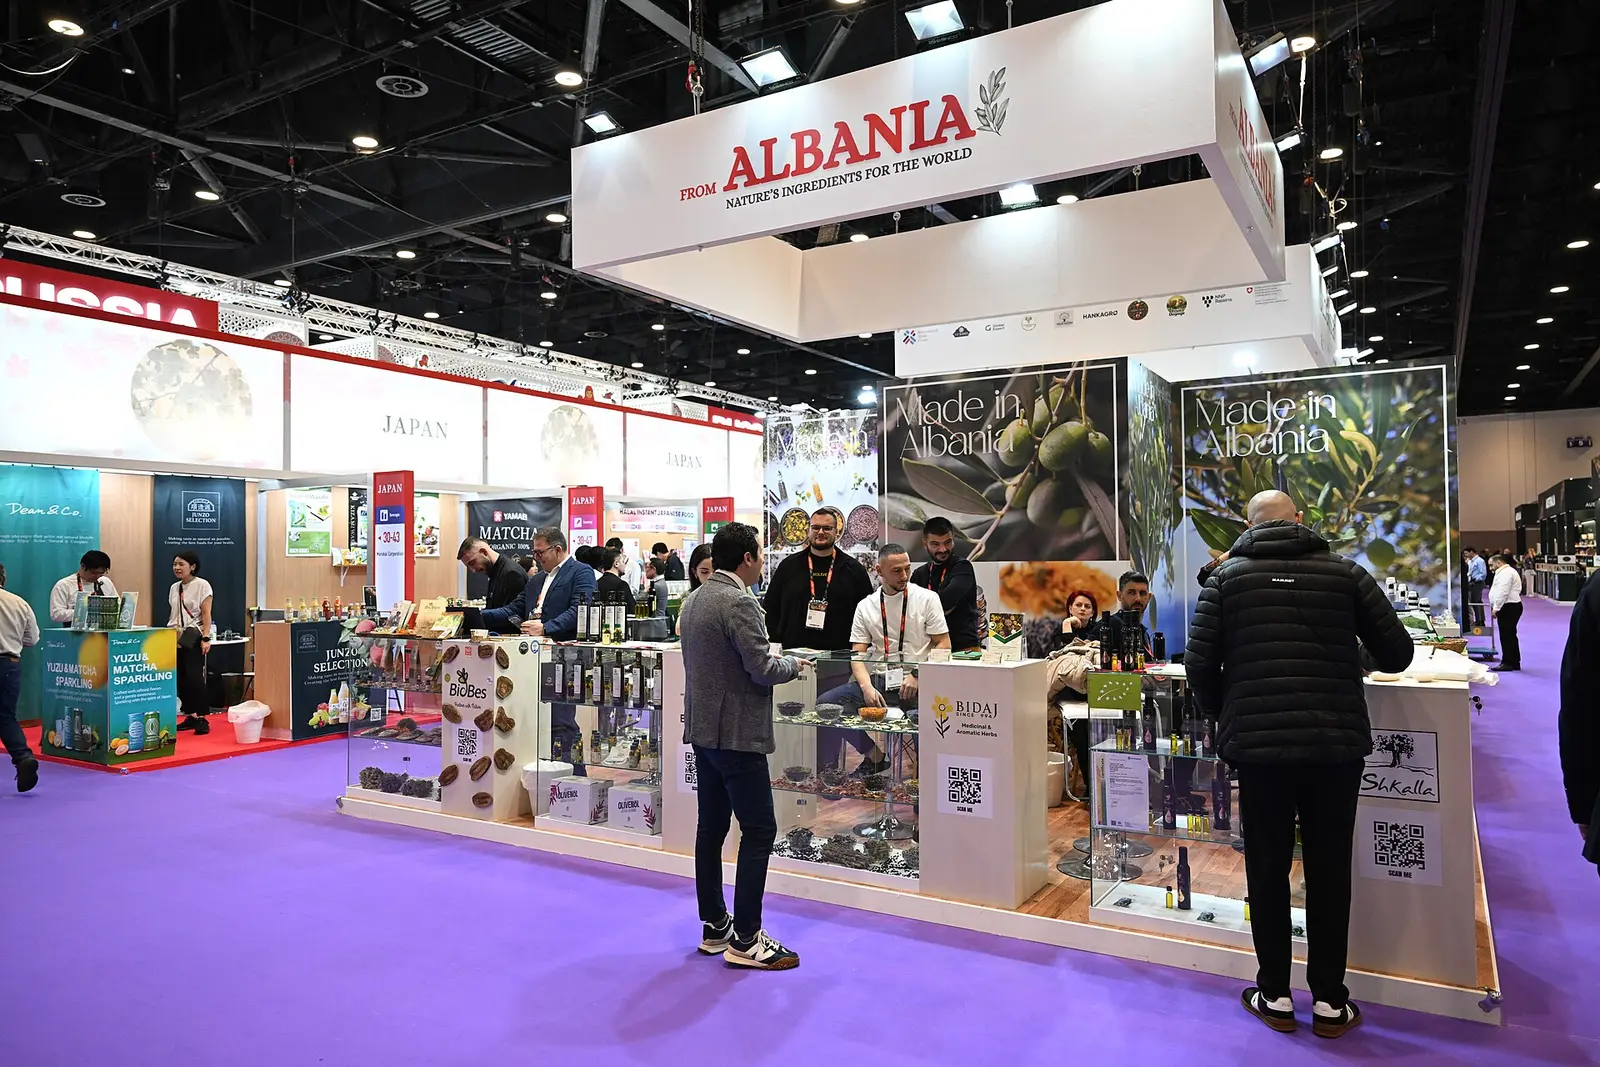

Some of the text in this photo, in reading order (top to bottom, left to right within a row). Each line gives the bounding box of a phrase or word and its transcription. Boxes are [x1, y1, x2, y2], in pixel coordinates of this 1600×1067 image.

[680, 94, 976, 201] FROM ALBANIA
[726, 147, 972, 210] NATURE'S INGREDIENTS FOR THE WORLD
[896, 389, 1020, 428] Made in
[1196, 390, 1296, 428] Made
[1308, 390, 1336, 420] in
[383, 415, 448, 439] JAPAN
[899, 424, 1014, 459] Albania
[1200, 424, 1329, 458] Albania
[666, 453, 702, 468] JAPAN
[378, 484, 402, 494] JAPAN
[572, 496, 594, 505] JAPAN
[6, 502, 82, 517] Dean & Co.
[383, 532, 400, 543] 30-43
[480, 526, 538, 540] MATCHA
[577, 536, 592, 545] 30-47
[113, 662, 157, 674] MATCHA
[314, 658, 368, 673] SELECTION
[56, 676, 92, 689] SPARKLING
[114, 672, 172, 685] SPARKLING
[450, 683, 487, 699] BioBes
[956, 701, 998, 718] BIDAJ
